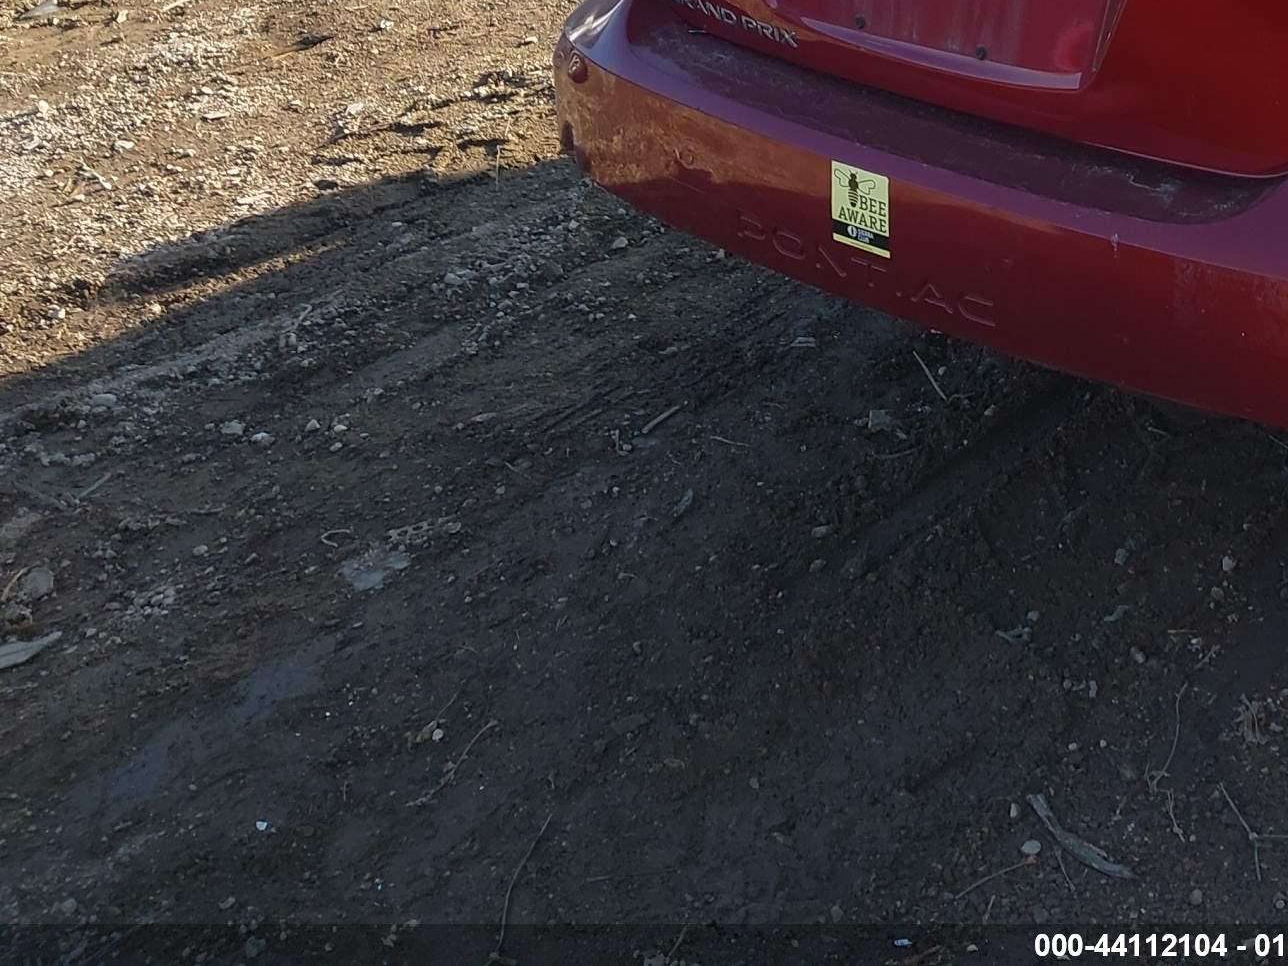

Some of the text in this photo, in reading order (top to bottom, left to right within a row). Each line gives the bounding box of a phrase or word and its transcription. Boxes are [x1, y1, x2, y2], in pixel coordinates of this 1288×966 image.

[741, 17, 799, 49] PRIX
[838, 205, 887, 233] AWARE
[859, 194, 887, 218] BEE
[738, 215, 996, 327] PONTAC
